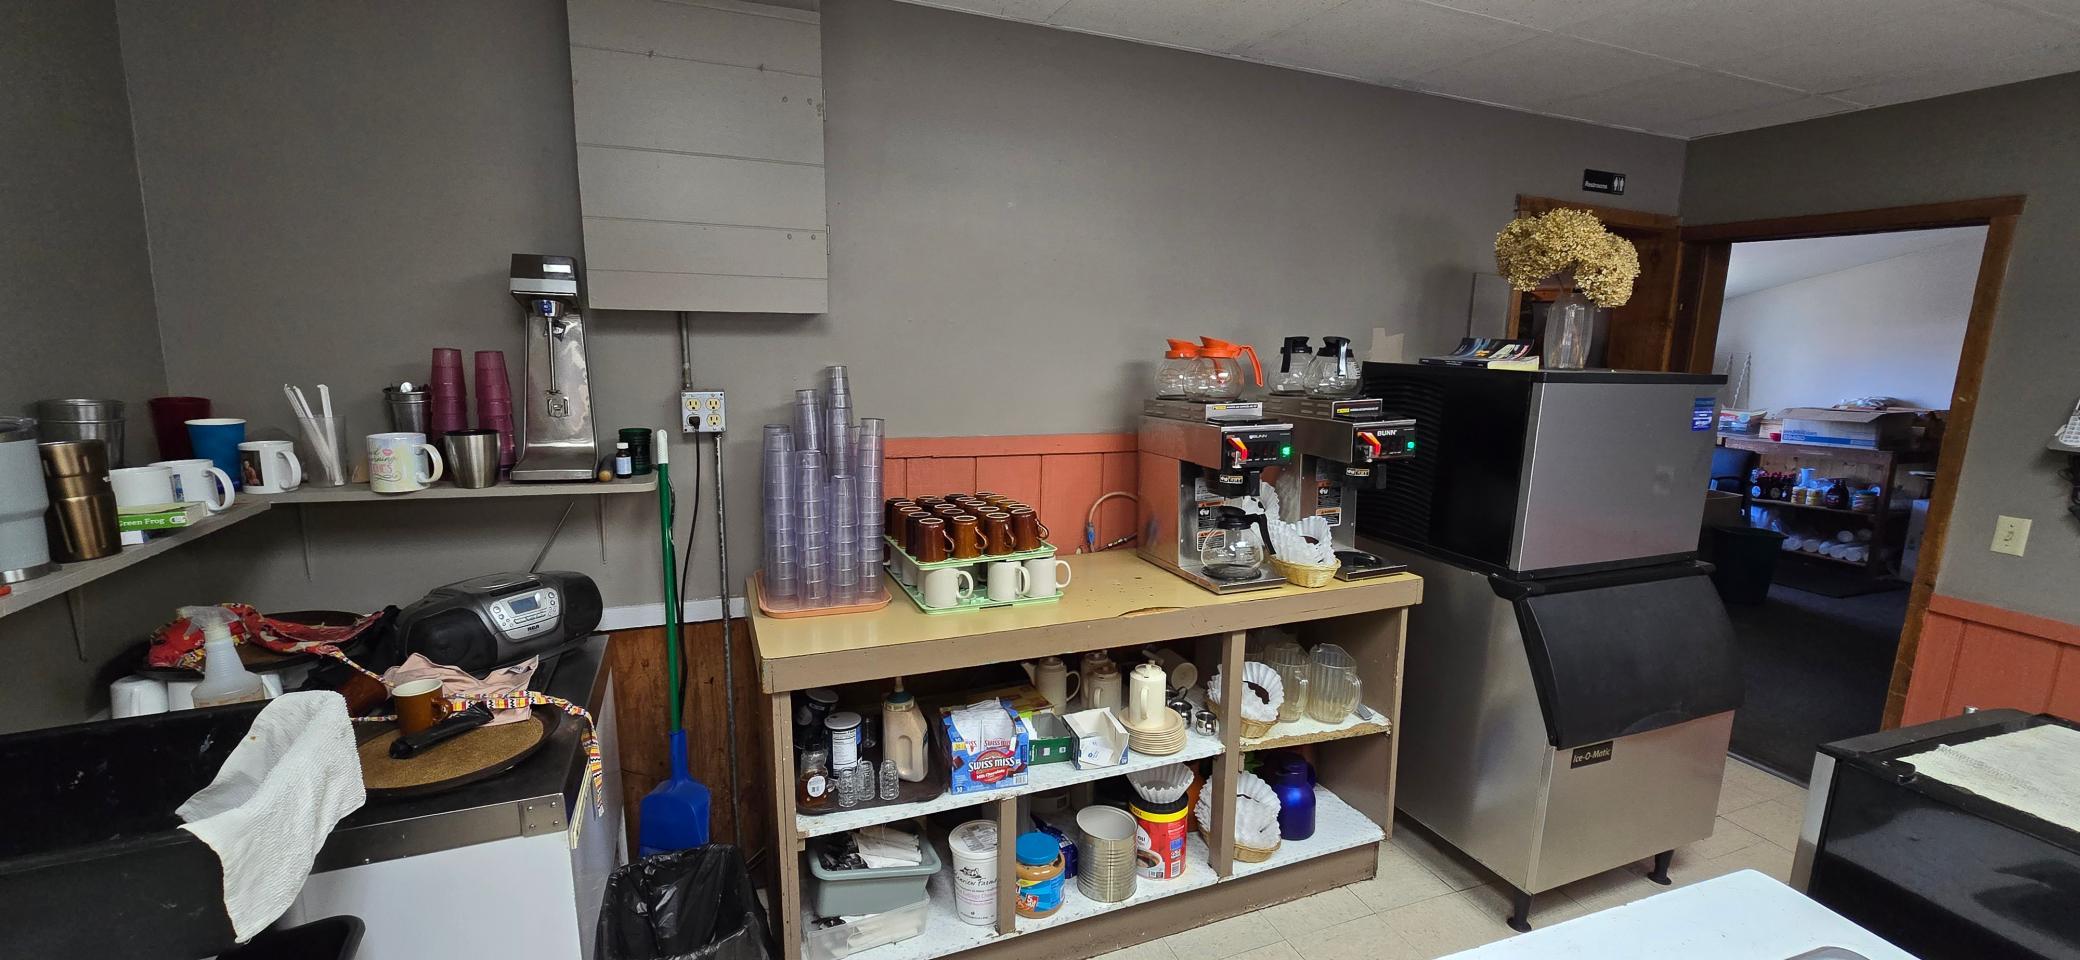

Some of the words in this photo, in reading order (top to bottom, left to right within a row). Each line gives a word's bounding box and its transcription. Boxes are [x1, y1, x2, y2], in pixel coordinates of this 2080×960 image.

[1377, 429, 1398, 437] BUNN
[527, 624, 540, 632] RCA
[1573, 747, 1611, 763] Ice-O-Matic
